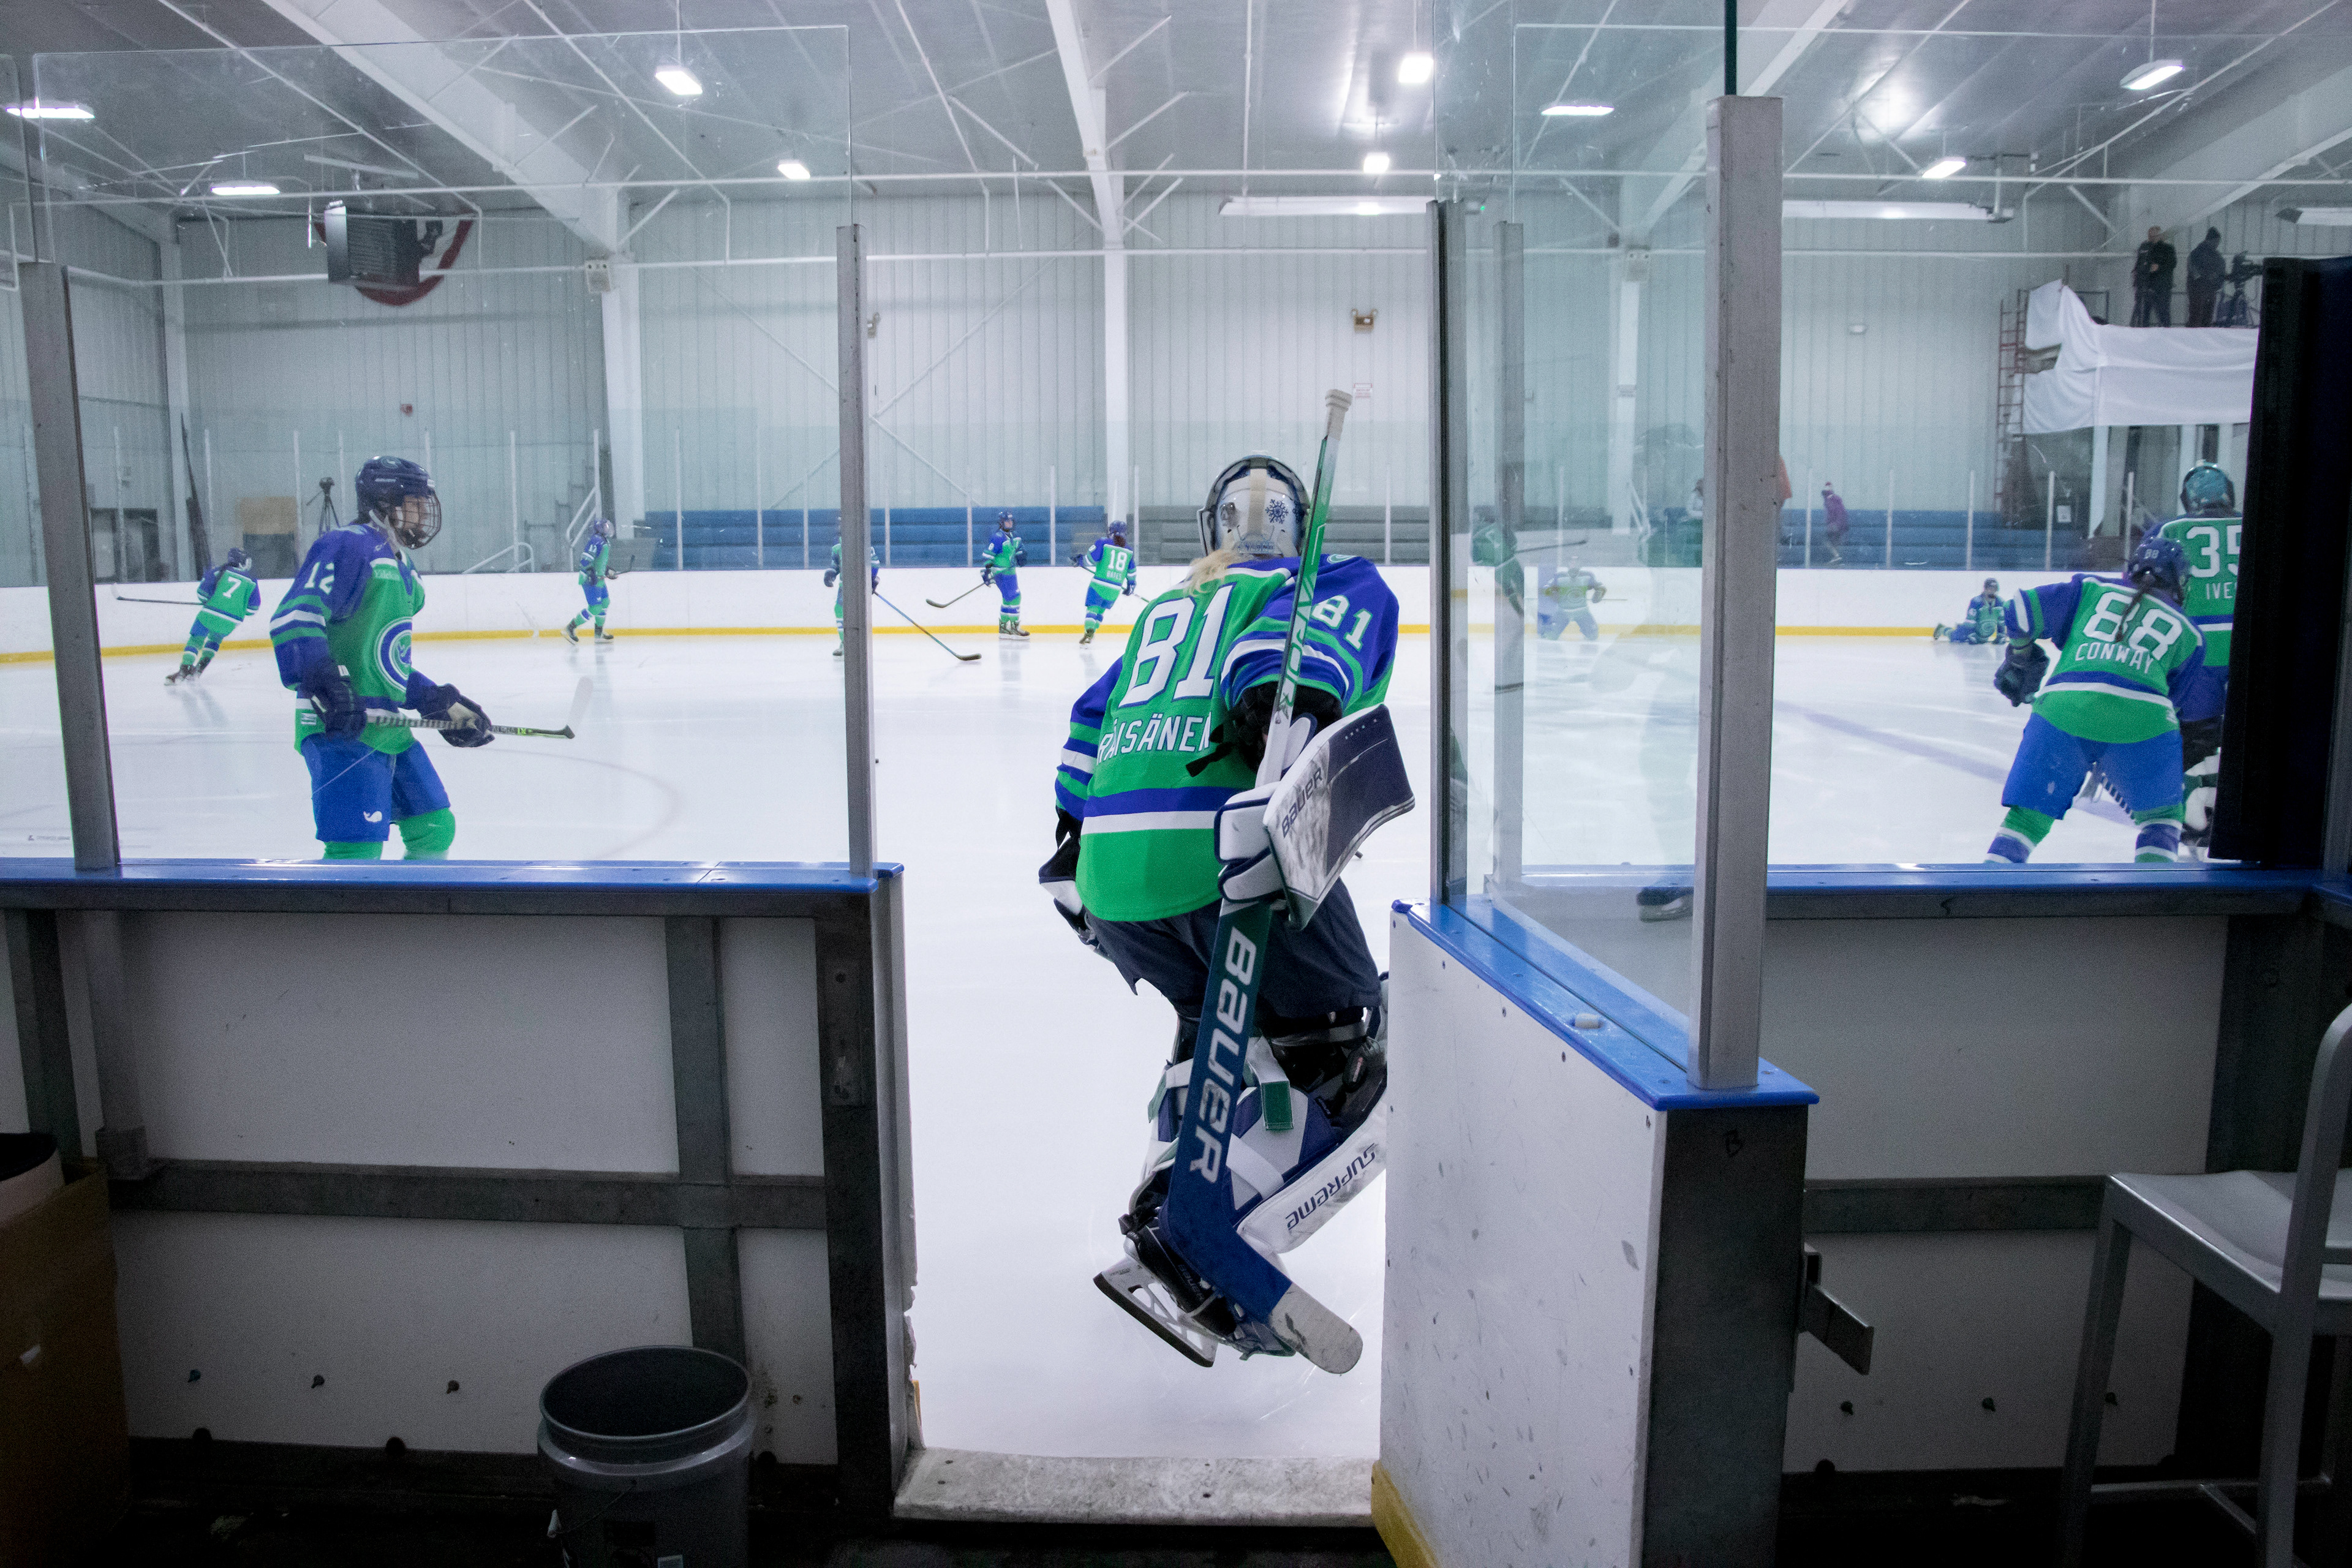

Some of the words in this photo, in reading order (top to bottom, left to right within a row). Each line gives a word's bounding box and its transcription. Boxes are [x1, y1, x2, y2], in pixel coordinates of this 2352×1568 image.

[1107, 549, 1128, 571] 18
[2145, 549, 2159, 559] 88
[222, 576, 242, 598] 7
[304, 562, 334, 595] 12
[2206, 581, 2237, 600] IVE
[1117, 581, 1237, 709] 81
[1310, 594, 1373, 652] 81
[2083, 591, 2182, 661] 88
[2075, 642, 2154, 674] CONWAY
[1281, 766, 1323, 839] BAUER
[1189, 925, 1257, 1184] BAUER
[1285, 1142, 1376, 1231] SUPREME
